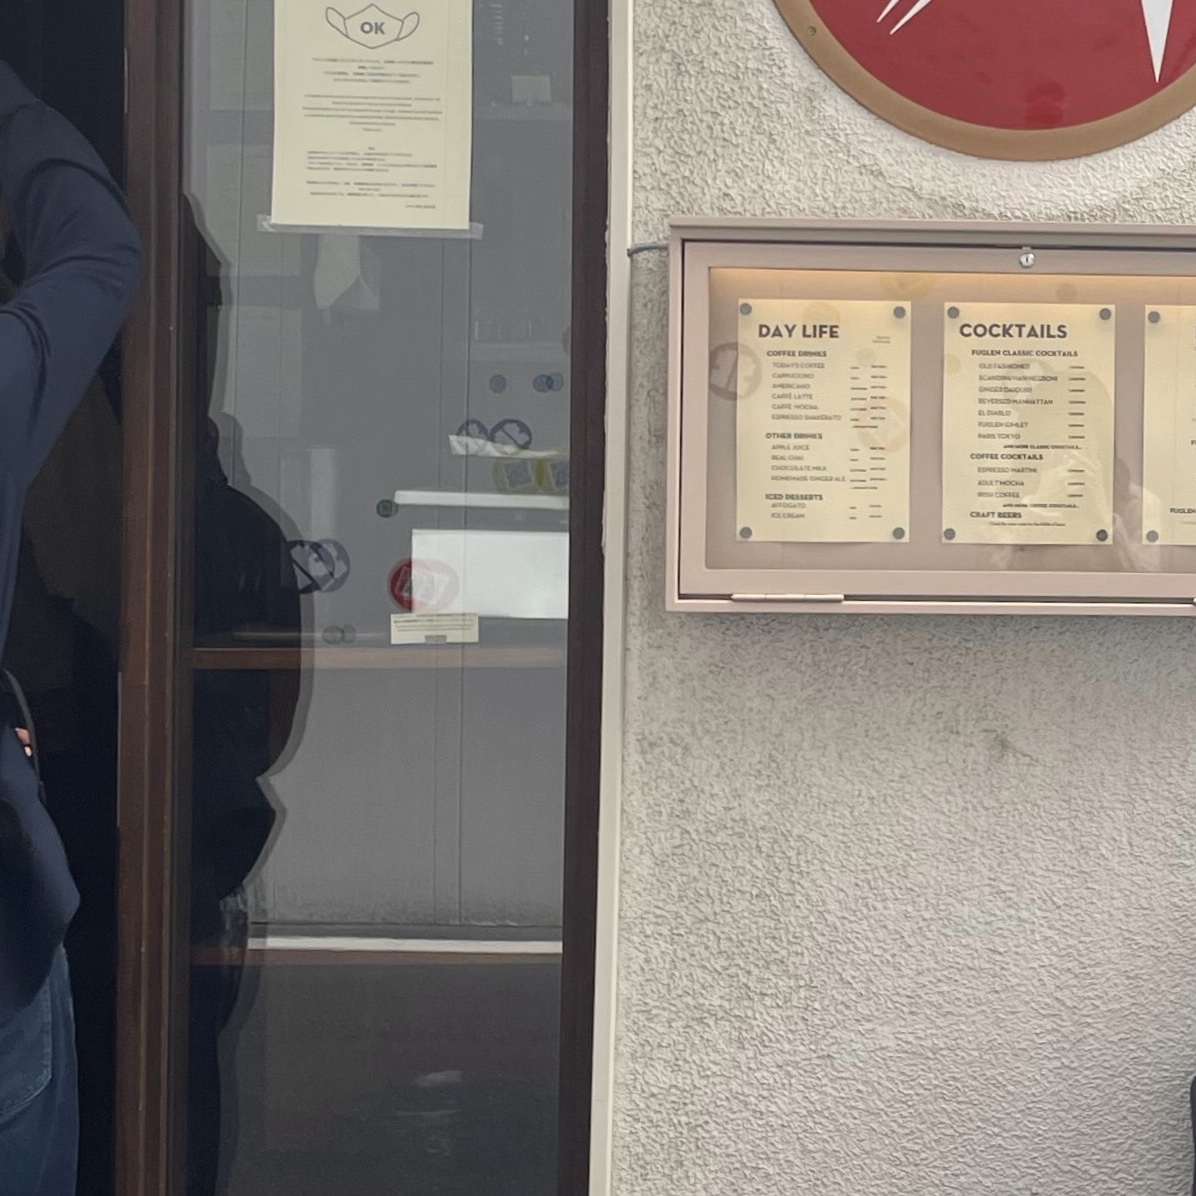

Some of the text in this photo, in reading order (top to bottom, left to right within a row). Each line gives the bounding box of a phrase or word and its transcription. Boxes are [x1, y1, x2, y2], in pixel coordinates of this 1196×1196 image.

[360, 22, 386, 35] OK
[758, 324, 840, 339] DAY LIFE
[959, 323, 1068, 339] COCKTAILS
[766, 350, 827, 358] COFFEE DRINKS
[765, 432, 823, 440] OTHER DRINKS
[765, 493, 823, 501] ICED DESSERTS
[969, 511, 1023, 519] CRAFT BEERS
[1170, 507, 1196, 515] FUGLEN
